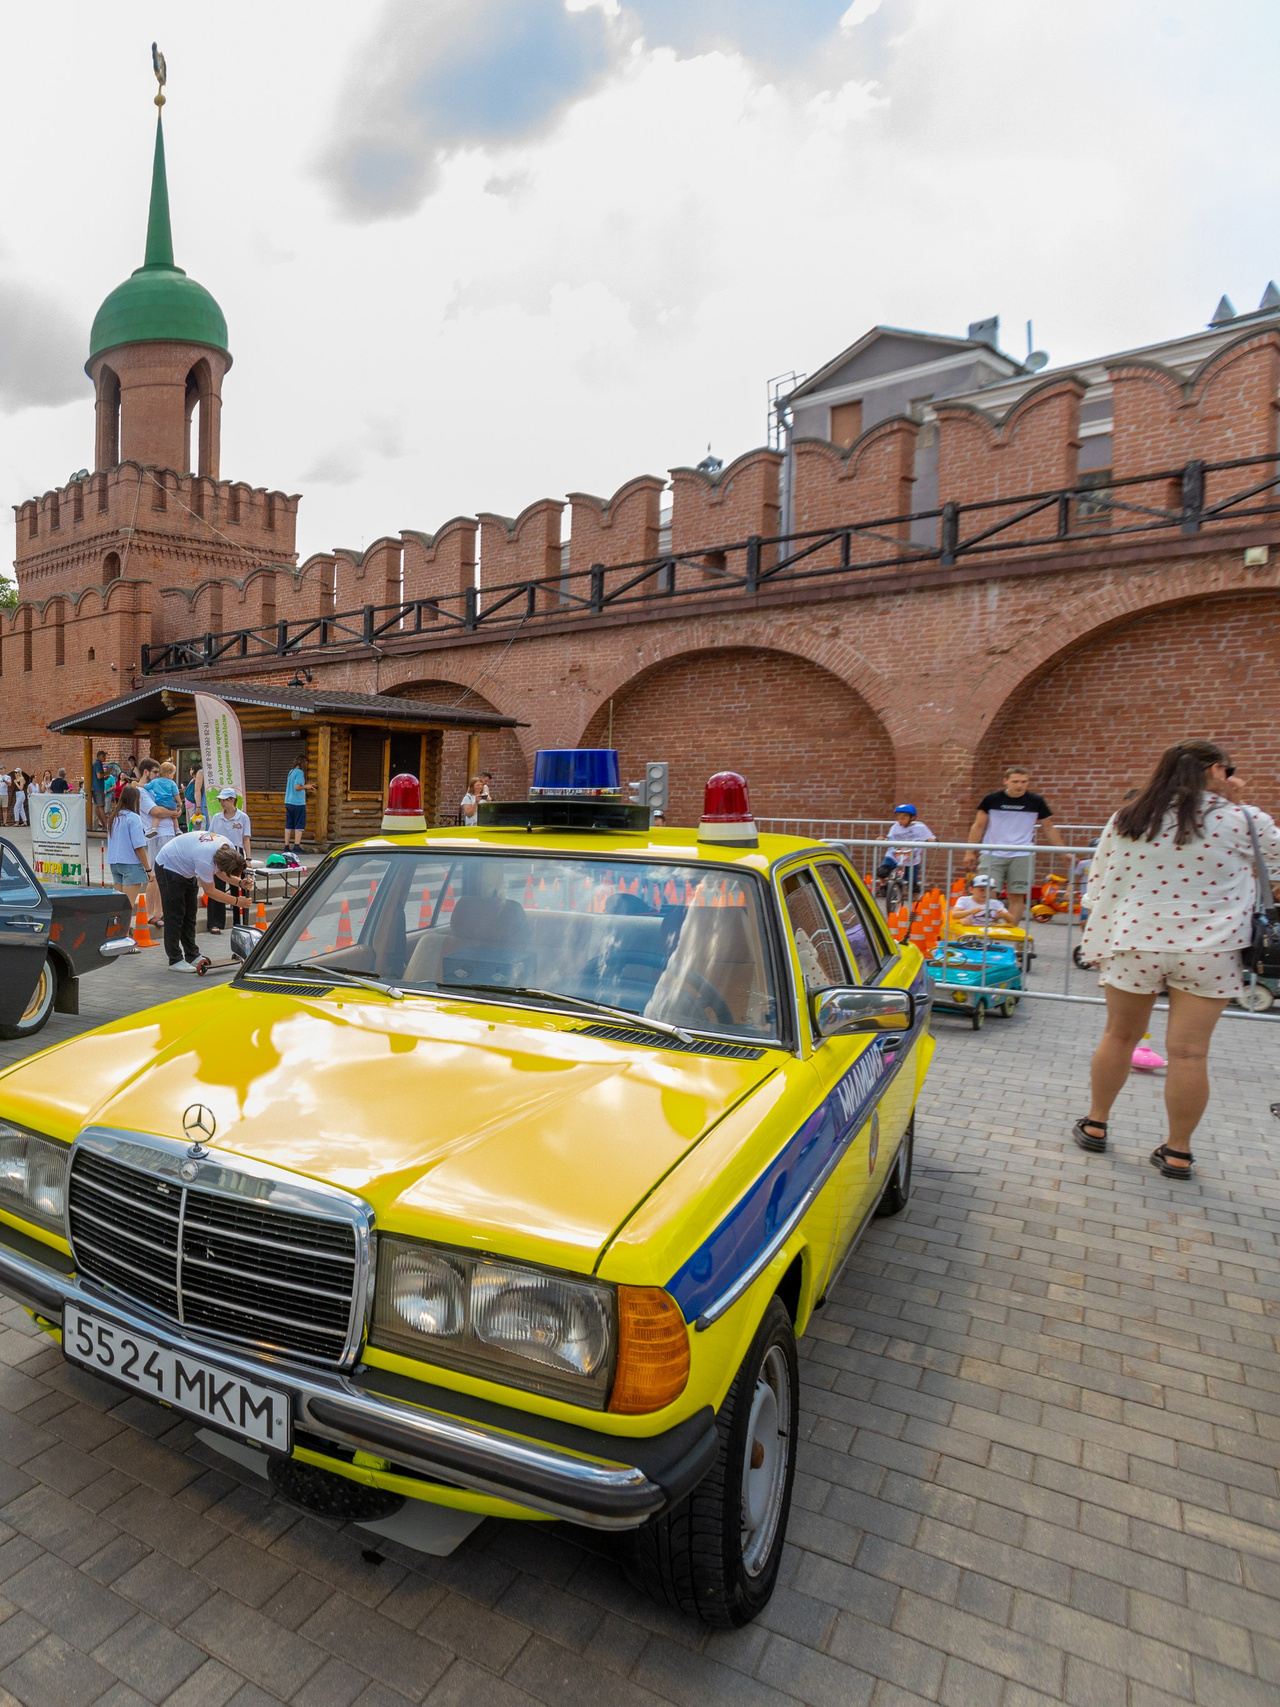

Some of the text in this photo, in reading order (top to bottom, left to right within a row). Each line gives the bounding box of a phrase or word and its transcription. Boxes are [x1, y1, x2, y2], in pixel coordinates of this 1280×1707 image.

[837, 1043, 884, 1121] МИЛИЦИЯ
[76, 1316, 273, 1439] 5524 МКМ
